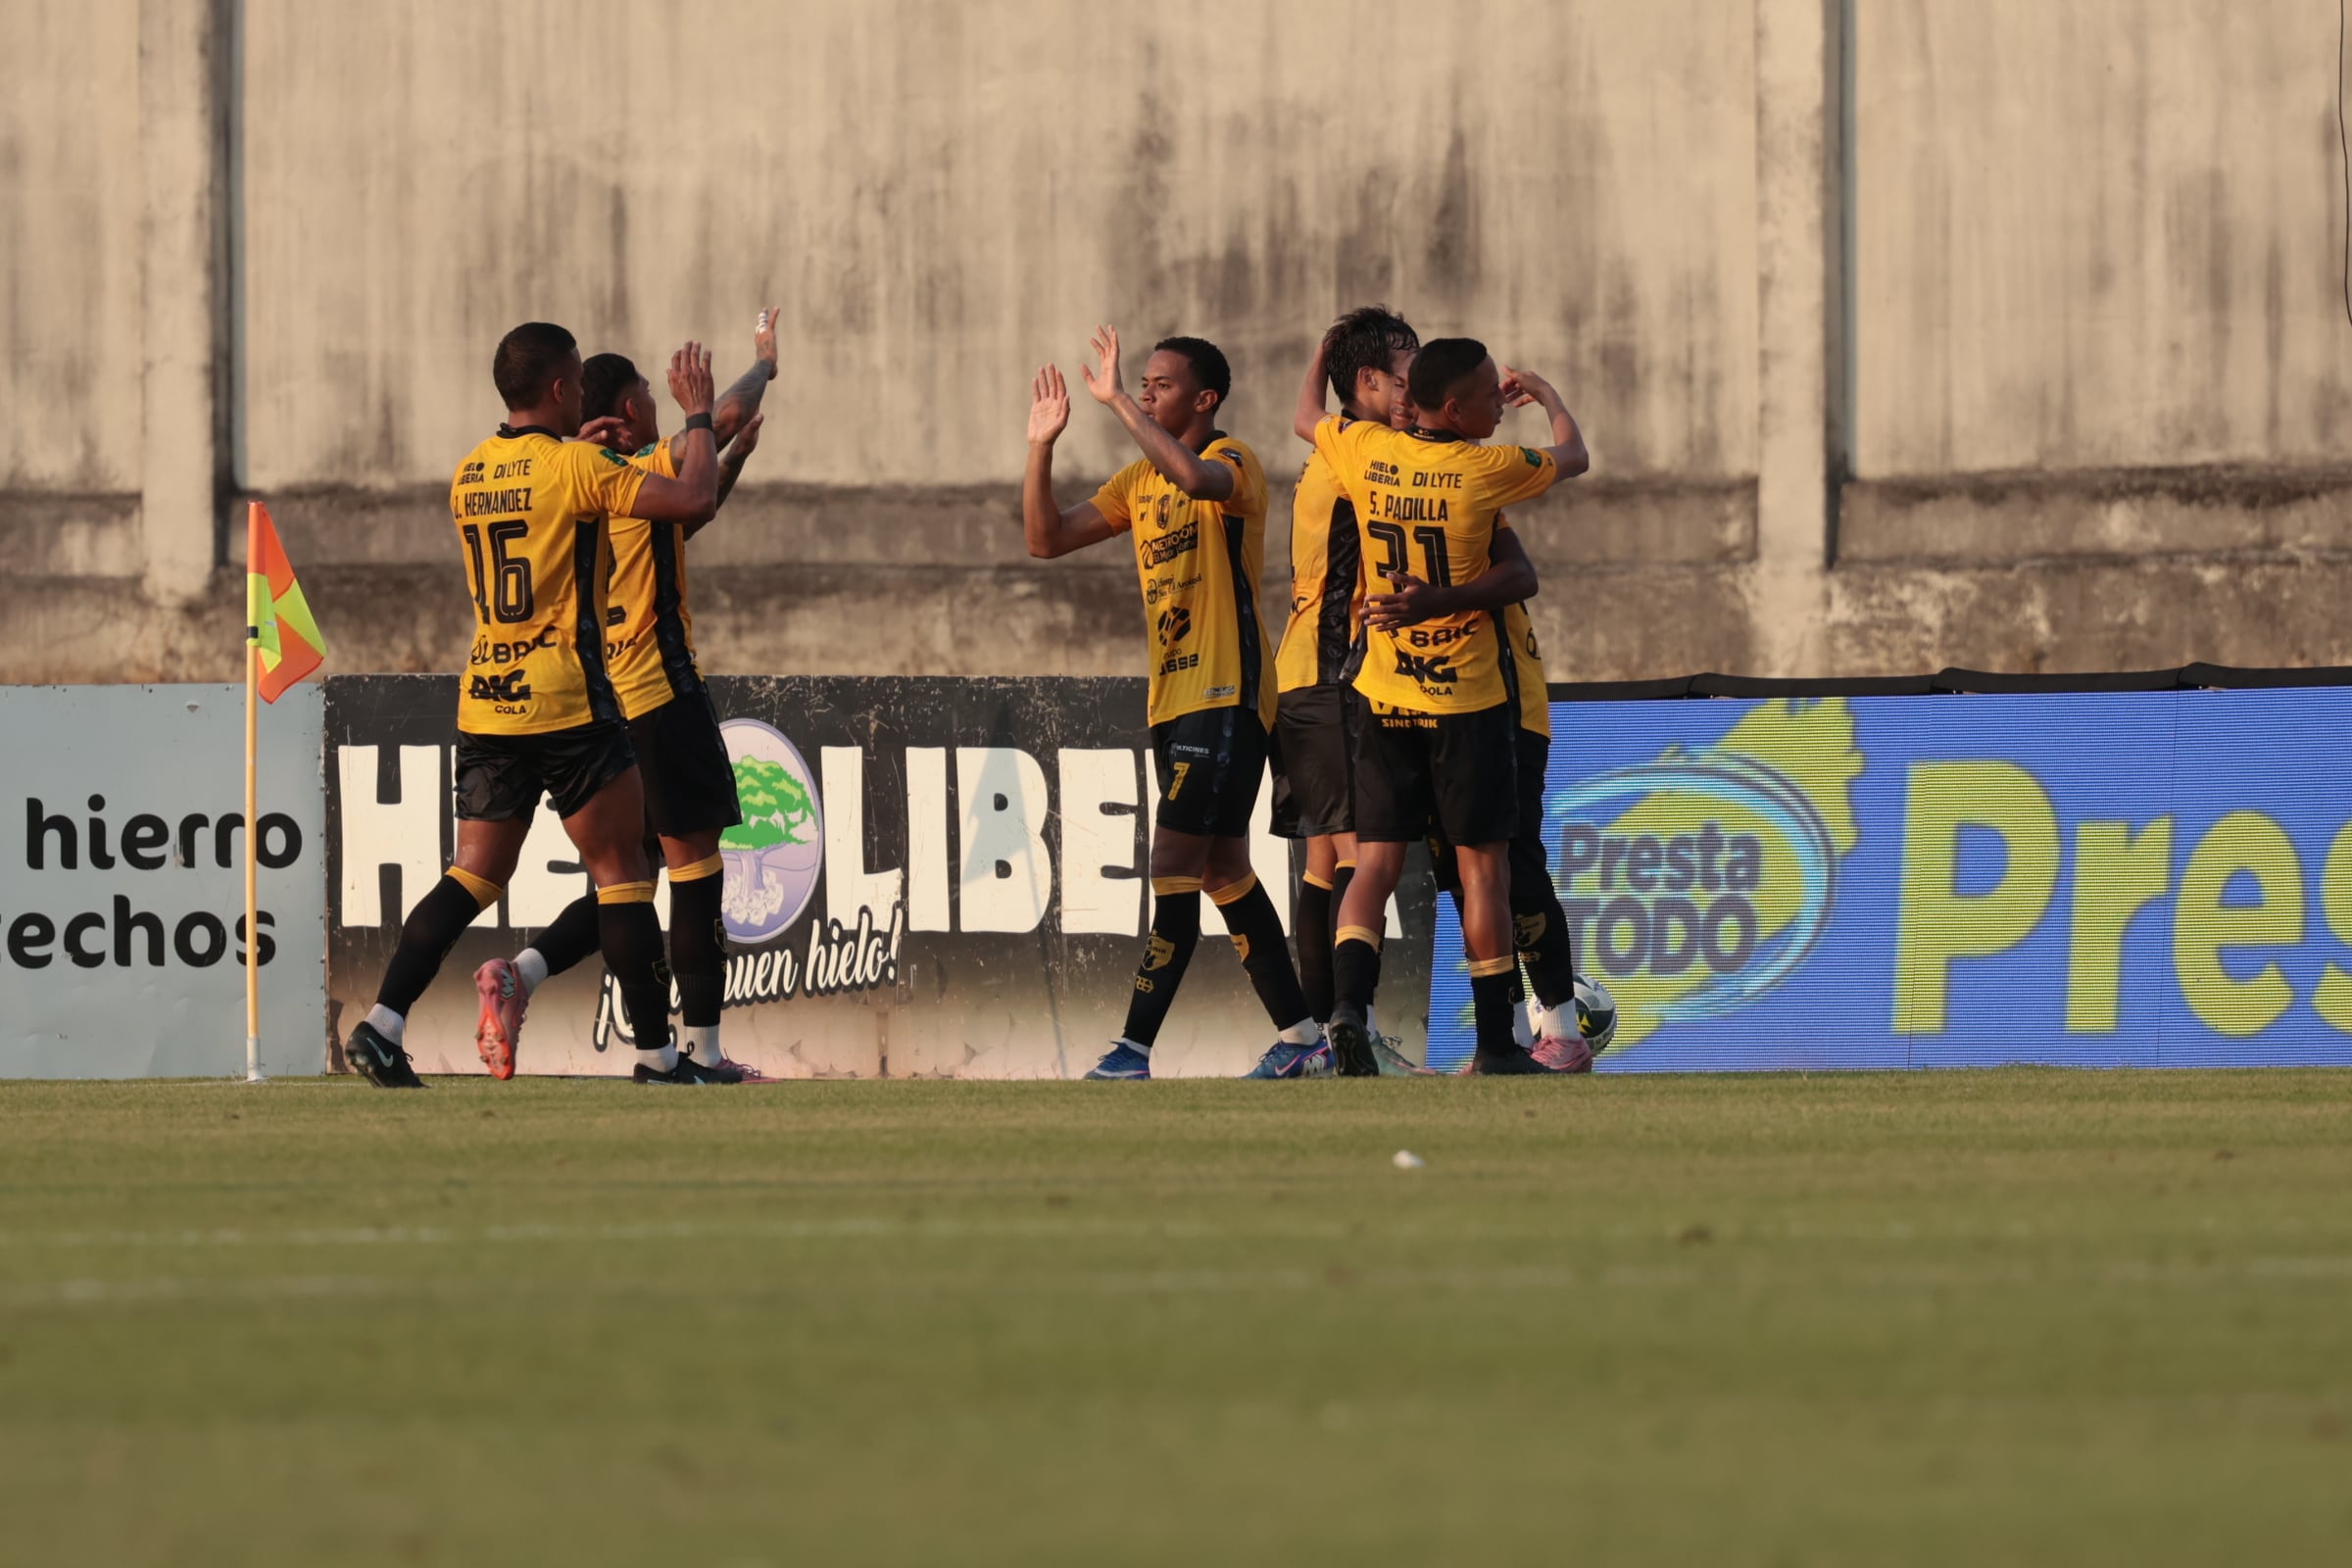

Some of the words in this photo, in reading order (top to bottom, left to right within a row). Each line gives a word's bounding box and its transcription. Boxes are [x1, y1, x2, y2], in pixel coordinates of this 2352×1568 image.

[465, 487, 532, 517] HERNANDEZ
[1364, 469, 1400, 487] LIBERIA
[1370, 490, 1380, 515] S.
[1385, 494, 1448, 521] PADILLA
[463, 518, 534, 625] 16
[1410, 618, 1476, 647] BAIC
[494, 705, 527, 715] COLA
[1167, 761, 1191, 801] 7
[26, 794, 302, 870] hierro
[1559, 821, 1762, 894] Presta
[0, 894, 276, 969] echos
[806, 906, 904, 992] hielo!
[1570, 895, 1762, 978] TODO
